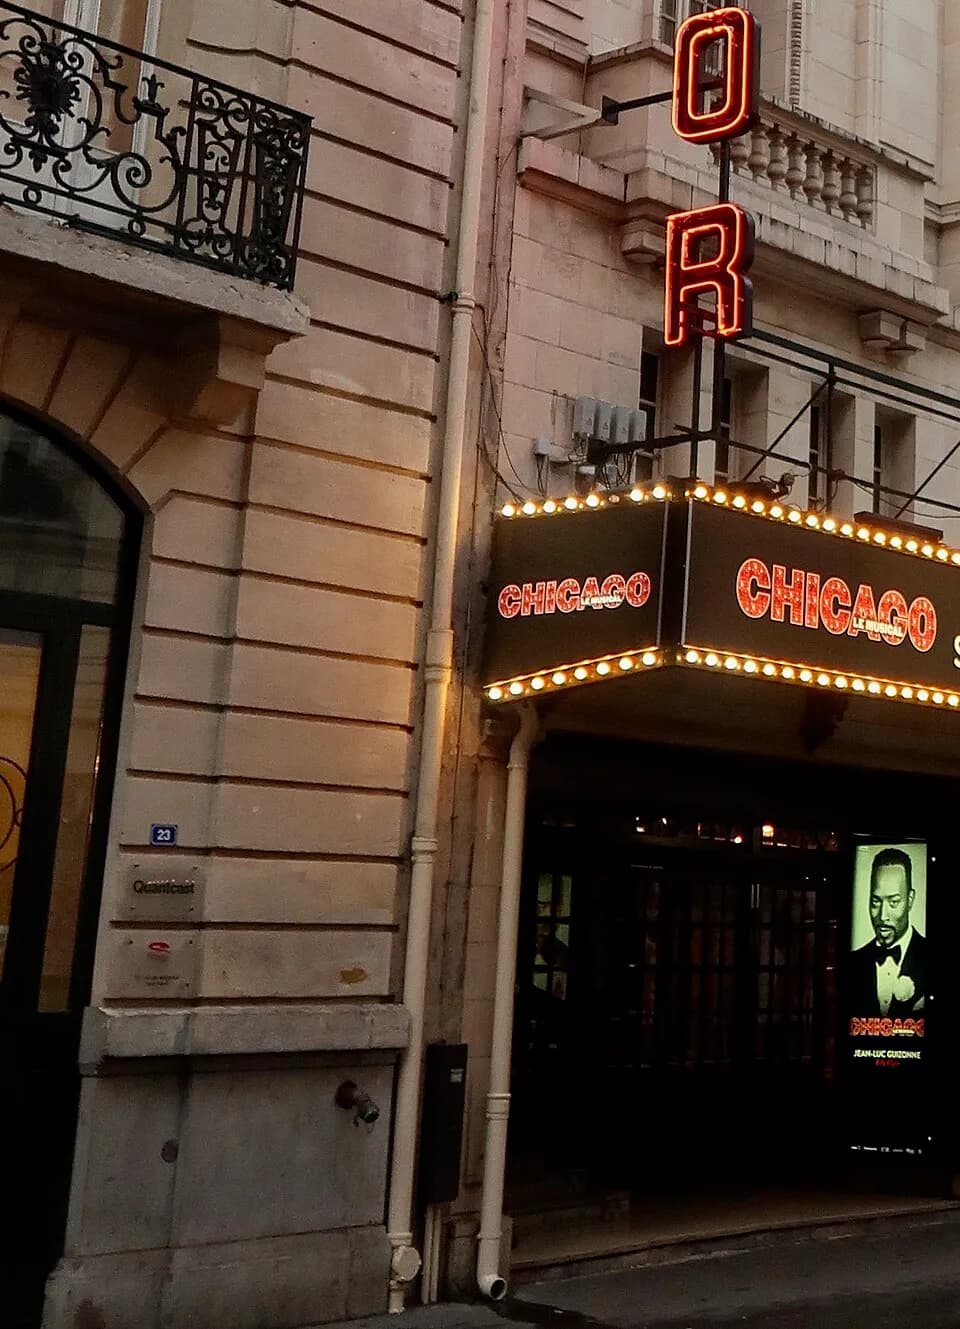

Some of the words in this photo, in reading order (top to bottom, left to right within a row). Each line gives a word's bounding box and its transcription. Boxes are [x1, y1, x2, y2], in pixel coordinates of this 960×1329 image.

[498, 571, 652, 618] CHICAGO
[736, 557, 937, 653] CHICAGO
[853, 617, 865, 629] LE
[865, 620, 904, 638] MUSICAL
[157, 829, 171, 841] 23
[133, 880, 195, 895] Quantcast
[853, 1049, 886, 1058] JEAN-LUC
